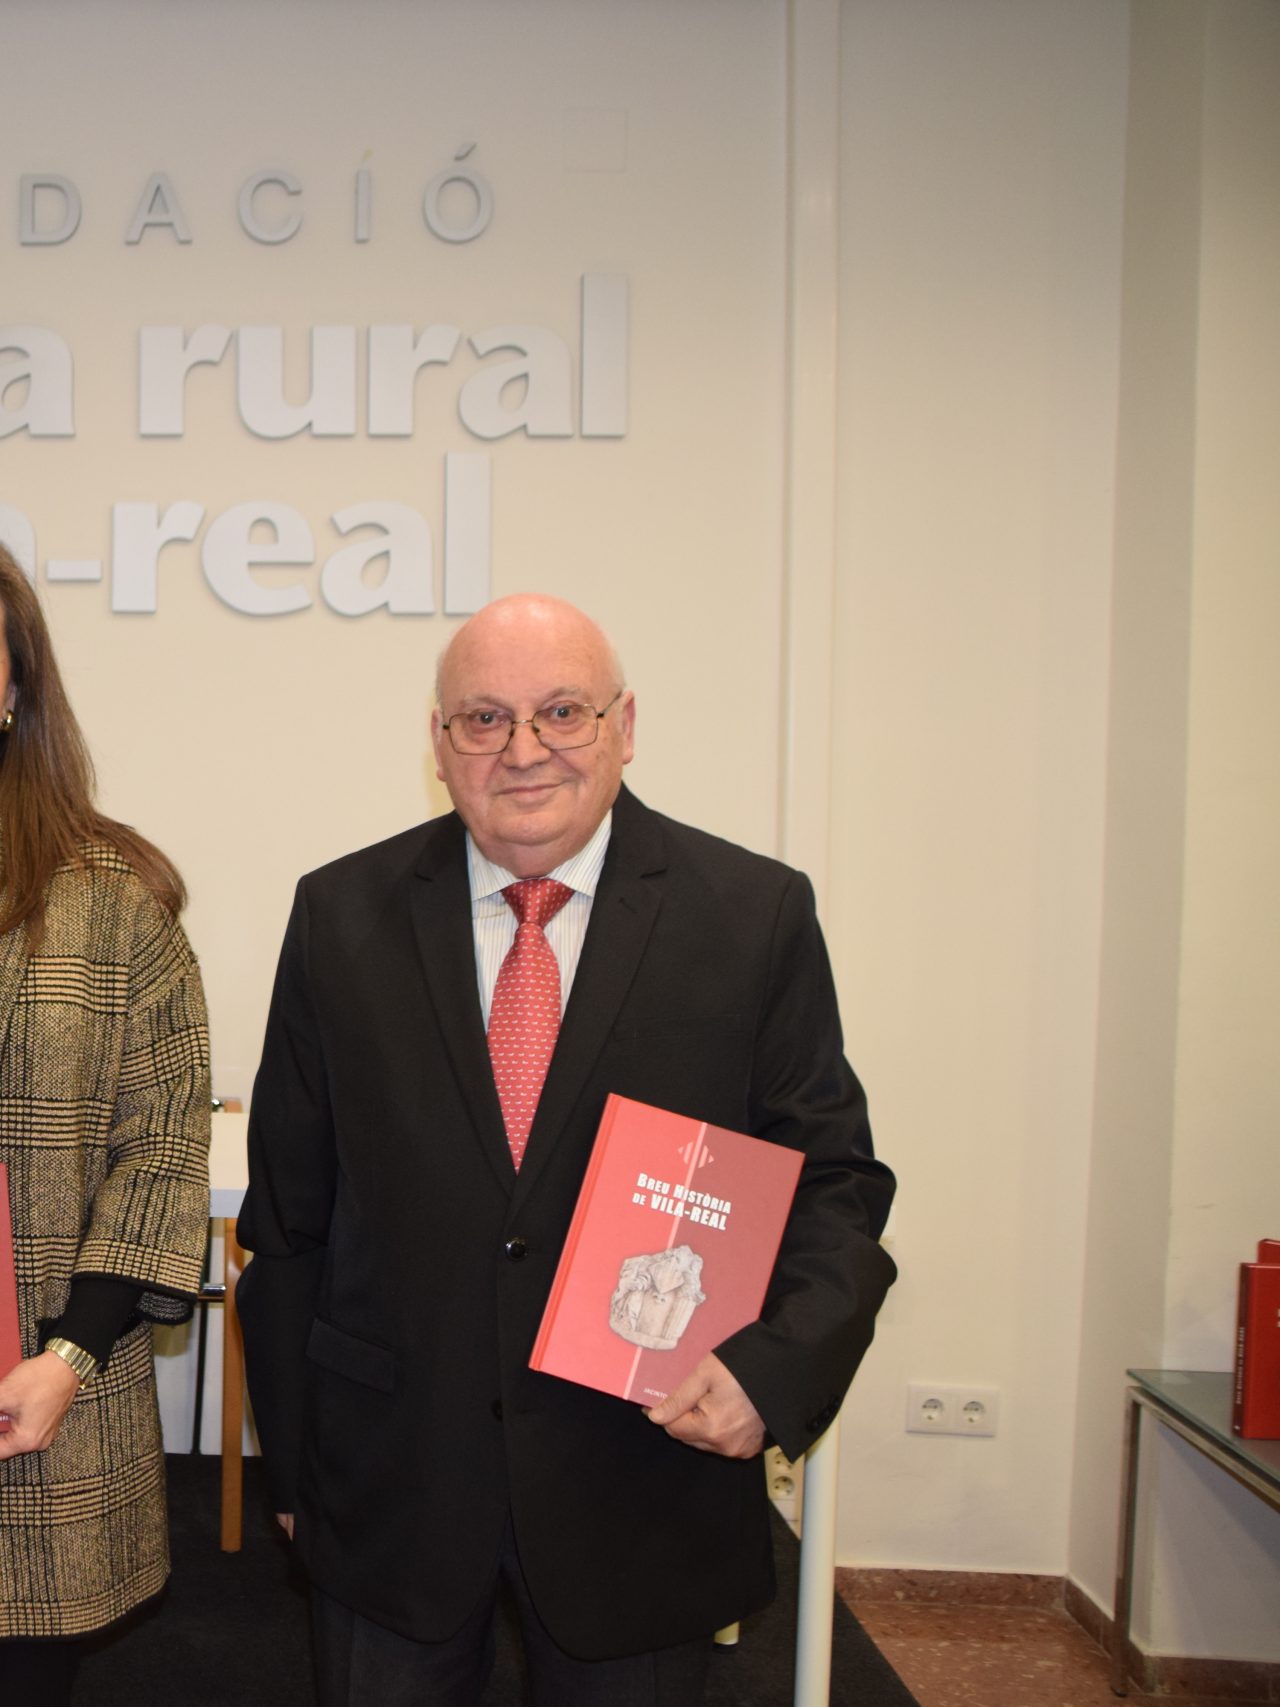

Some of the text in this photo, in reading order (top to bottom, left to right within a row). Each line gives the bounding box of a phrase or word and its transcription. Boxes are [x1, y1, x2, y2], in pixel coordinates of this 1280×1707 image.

[138, 273, 629, 442] rural
[632, 1192, 727, 1231] DE VILA-REAL
[637, 1172, 732, 1215] BREU HISTÒRIA
